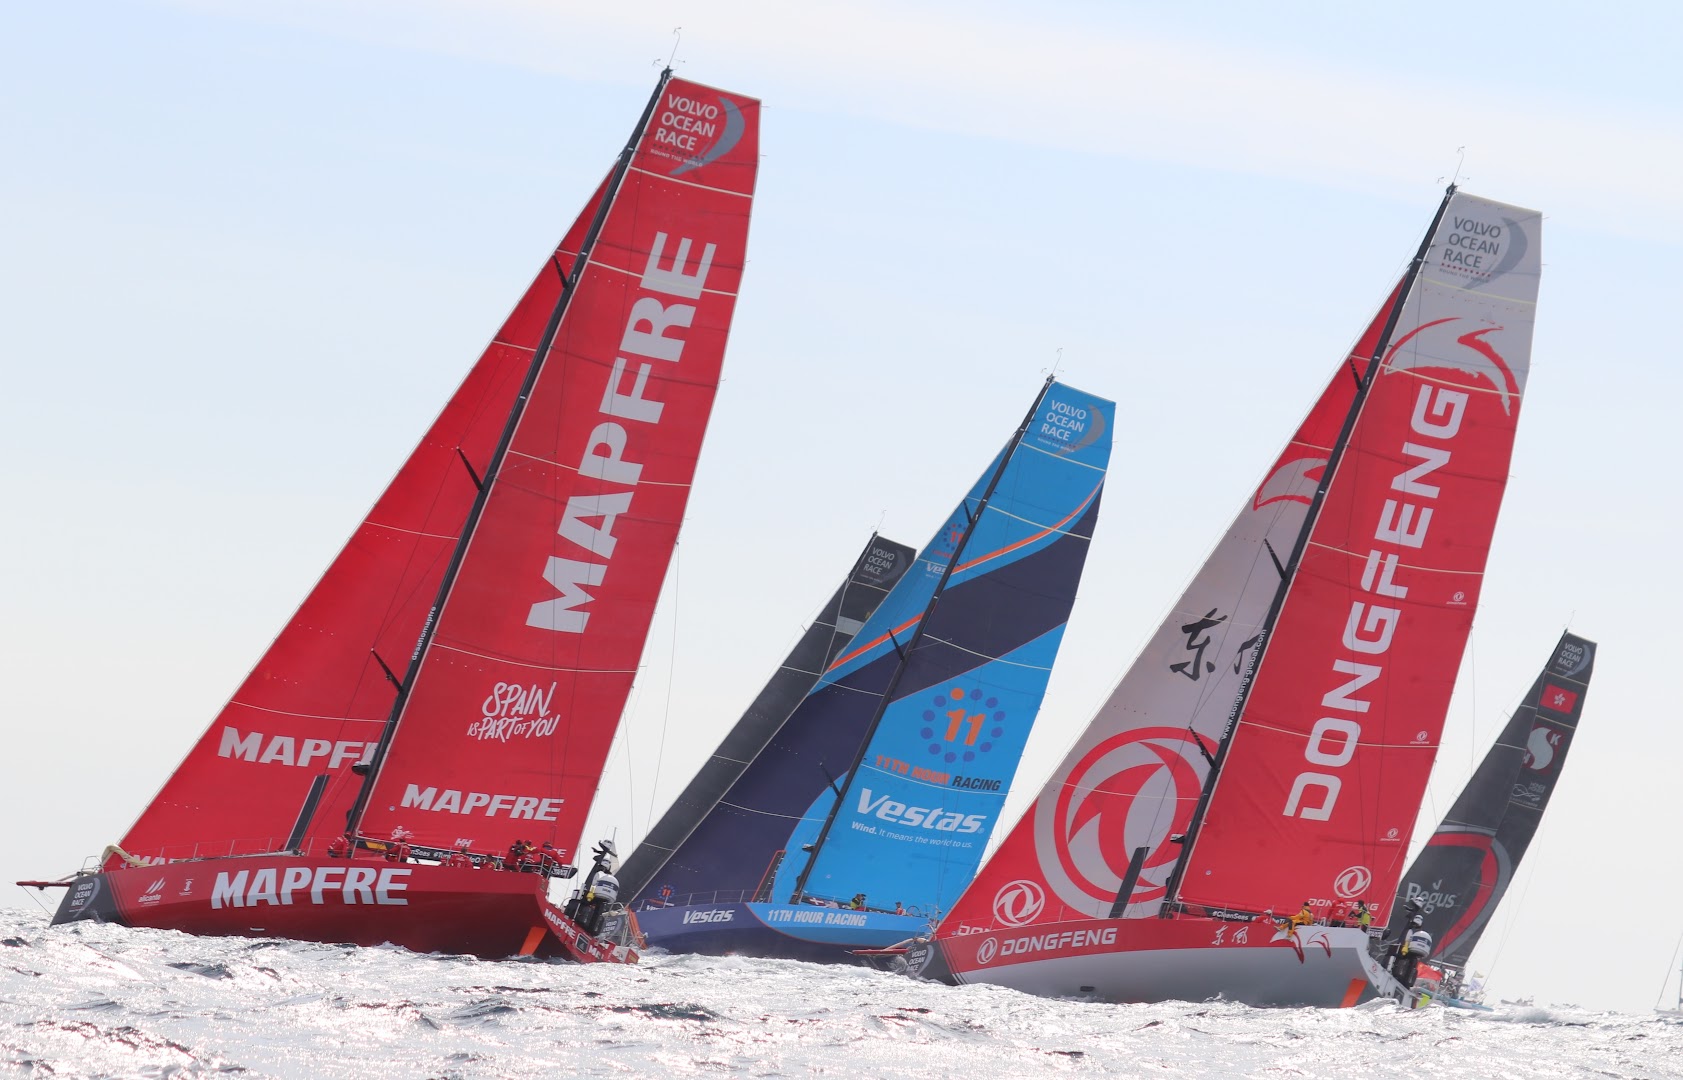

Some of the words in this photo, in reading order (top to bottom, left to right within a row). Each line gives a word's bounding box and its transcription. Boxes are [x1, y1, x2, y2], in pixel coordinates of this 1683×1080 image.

[668, 93, 718, 119] VOLVO
[661, 111, 716, 137] OCEAN
[655, 127, 697, 151] RACE
[650, 148, 670, 158] ROUND
[671, 154, 682, 162] THE
[682, 159, 703, 167] WORLD
[1454, 216, 1501, 238] VOLVO
[1448, 233, 1500, 255] OCEAN
[1443, 248, 1483, 268] RACE
[1051, 399, 1087, 420] VOLVO
[1041, 423, 1071, 441] RACE
[1046, 412, 1085, 432] OCEAN
[525, 231, 717, 634] MAPFRE
[868, 555, 892, 569] OCEAN
[872, 547, 895, 560] VOLVO
[863, 563, 883, 575] RACE
[1282, 383, 1469, 822] DONGFENG
[1561, 650, 1581, 662] OCEAN
[1564, 643, 1583, 655] VOLVO
[1558, 657, 1574, 668] RACE
[478, 716, 523, 743] PART
[514, 722, 531, 735] OF
[525, 714, 560, 739] YOU
[944, 707, 987, 746] 11
[875, 754, 910, 775] 11TH
[911, 766, 951, 785] HOUR
[952, 775, 1001, 791] RACING
[400, 783, 564, 821] MAPFRE
[857, 787, 987, 833] Vestas
[454, 838, 473, 848] HH
[851, 821, 877, 835] Wind.
[886, 831, 913, 842] means
[914, 836, 928, 844] the
[929, 838, 951, 847] world
[952, 840, 961, 848] to
[75, 890, 92, 899] OCEAN
[78, 882, 93, 890] VOLVO
[210, 866, 412, 910] MAPFRE
[71, 899, 85, 907] RACE
[1405, 882, 1457, 914] Regus
[544, 909, 576, 939] MAPFRE
[682, 909, 735, 924] Vestas
[768, 909, 792, 922] 11TH
[793, 910, 821, 924] HOUR
[824, 913, 867, 927] RACING
[1212, 910, 1249, 921] #CleanSeas
[1000, 927, 1118, 956] DONGFENG
[908, 957, 926, 965] OCEAN
[911, 950, 927, 958] VOLVO
